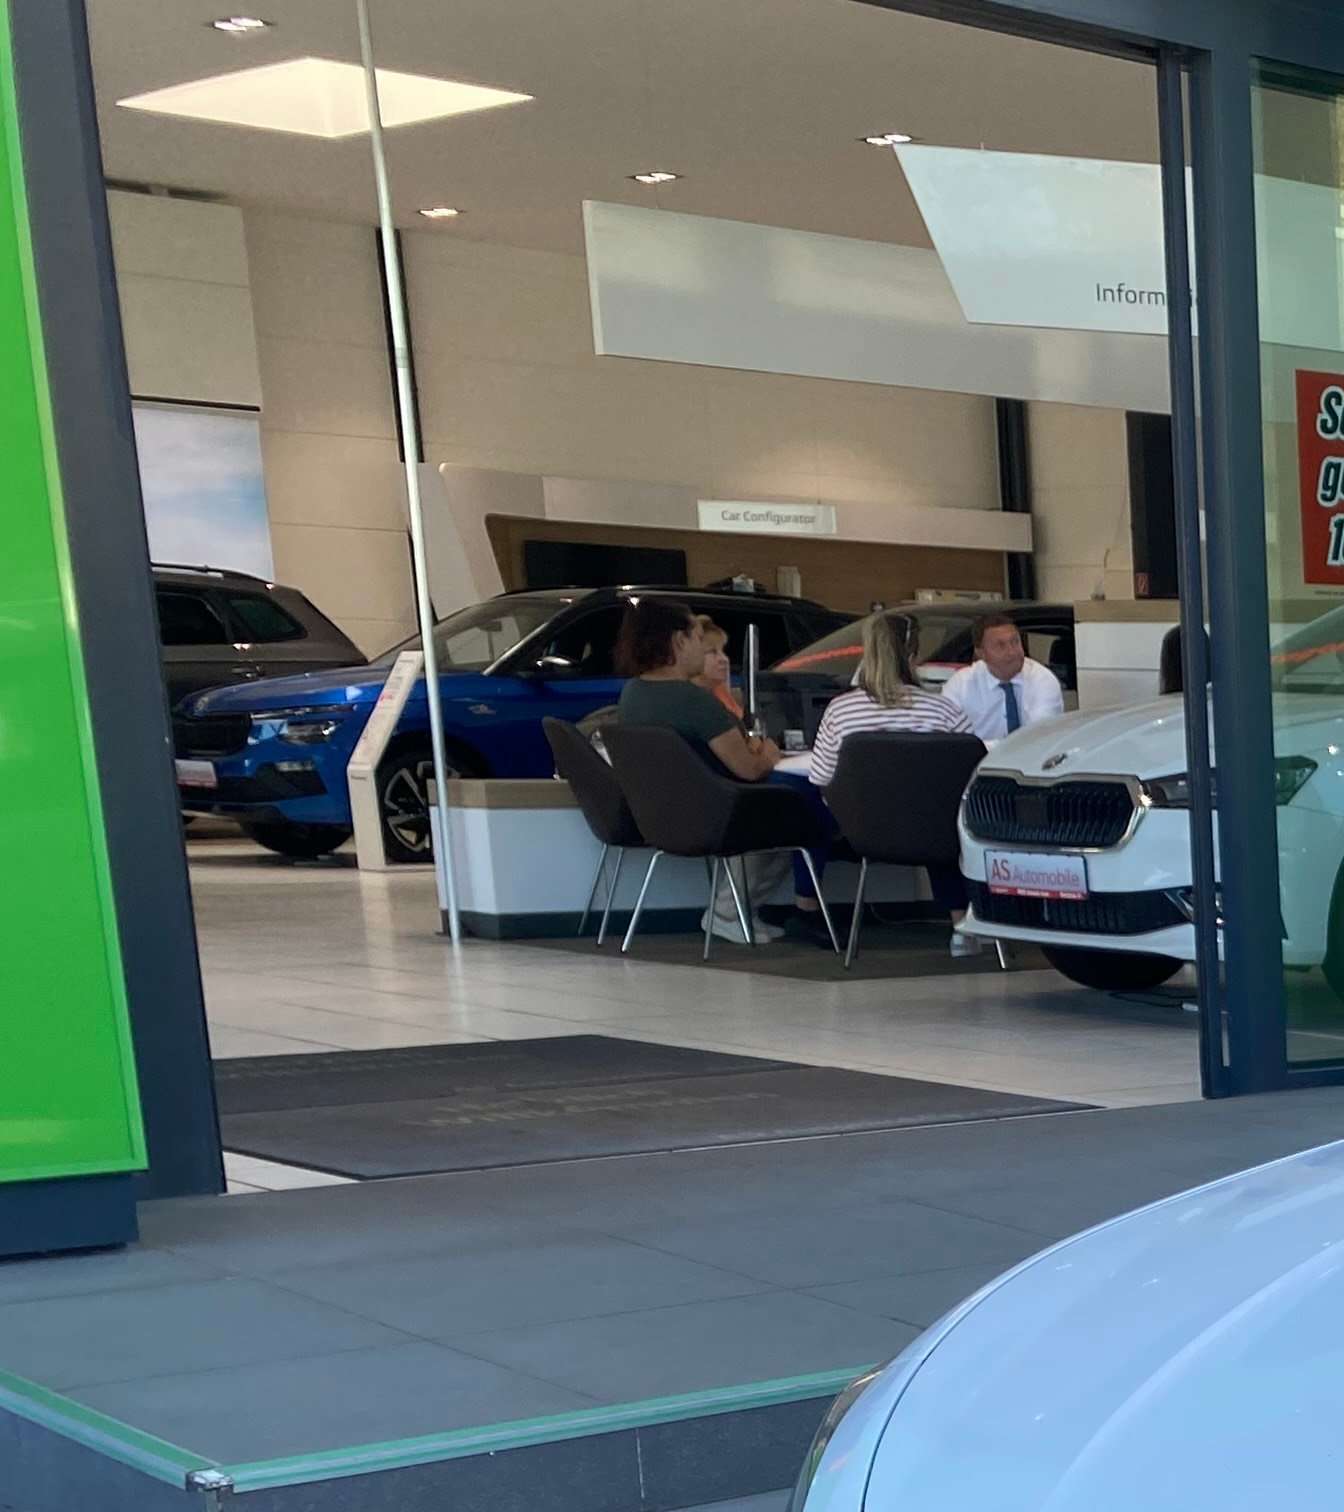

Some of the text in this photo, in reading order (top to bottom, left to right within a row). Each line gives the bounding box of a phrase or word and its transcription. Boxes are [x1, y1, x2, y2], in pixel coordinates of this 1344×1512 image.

[1096, 282, 1166, 306] Inform
[721, 510, 816, 526] Car Configurator
[992, 858, 1080, 887] AS Automobile
